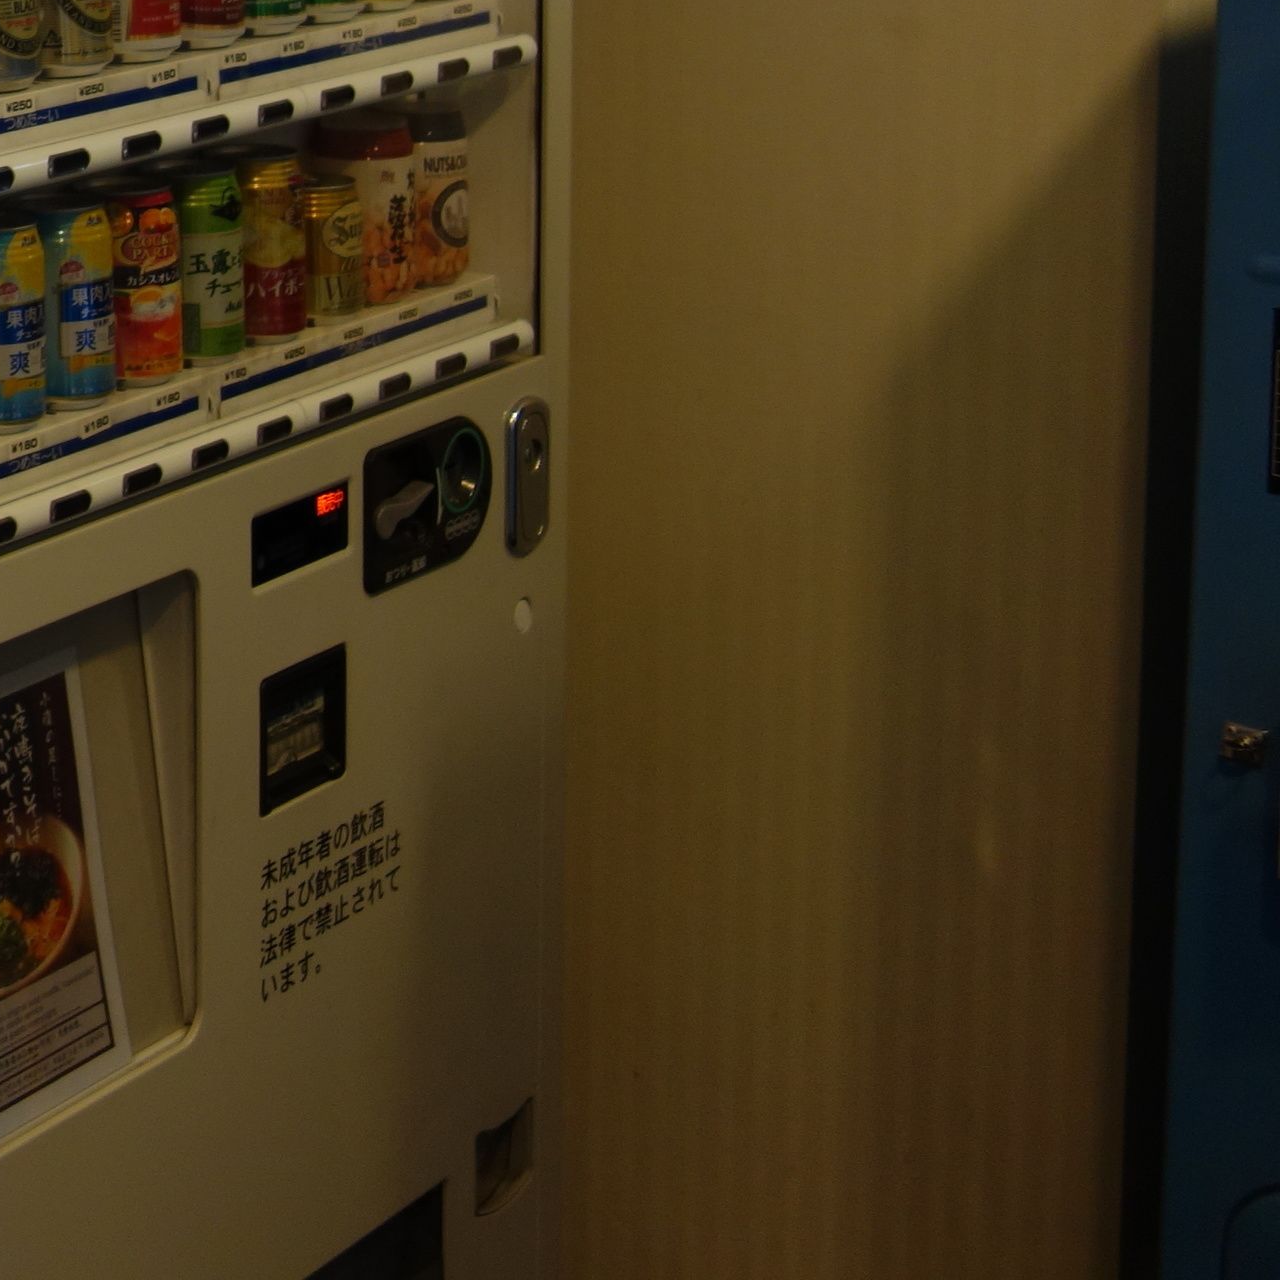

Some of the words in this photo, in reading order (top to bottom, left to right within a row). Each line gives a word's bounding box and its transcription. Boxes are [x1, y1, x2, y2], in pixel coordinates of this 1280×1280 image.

[6, 98, 34, 113] ¥250
[79, 82, 105, 97] ¥250
[11, 437, 39, 454] ¥180
[260, 799, 385, 891] 未成年者の飲酒
[261, 829, 401, 929] および飲酒運転は
[260, 864, 402, 969] 法律で禁止されて
[261, 949, 322, 1003] います。
